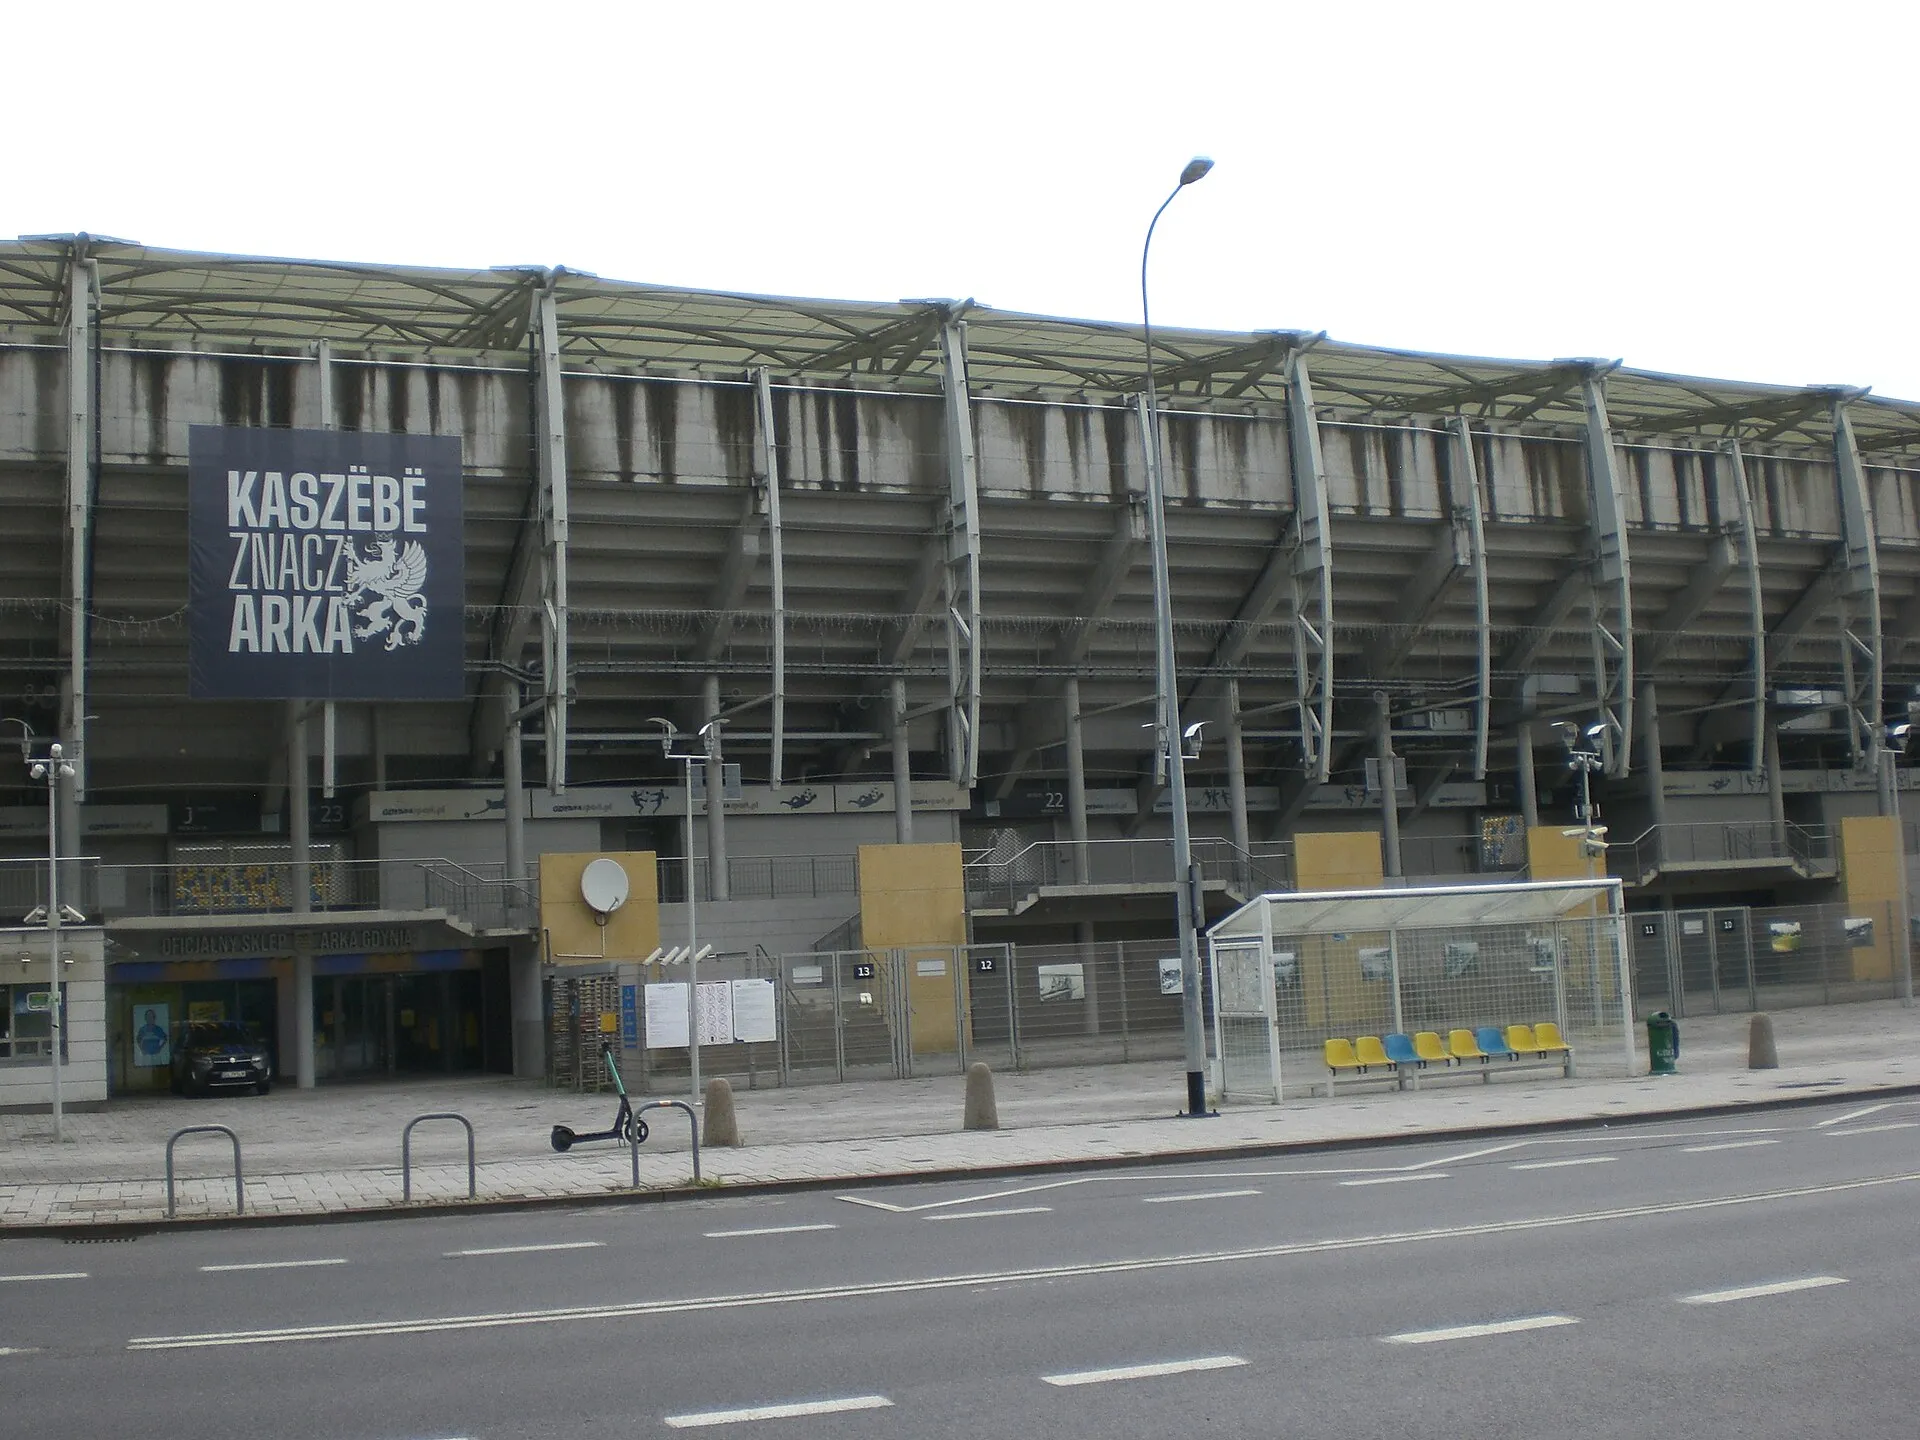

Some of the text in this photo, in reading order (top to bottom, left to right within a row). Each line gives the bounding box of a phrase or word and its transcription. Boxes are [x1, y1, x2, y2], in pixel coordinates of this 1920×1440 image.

[228, 465, 427, 532] KASZËBË
[228, 594, 353, 653] ARKA
[1045, 791, 1064, 808] 22
[320, 805, 344, 823] 23
[161, 928, 412, 956] OFICJALNY SKLEP ARKA GDYNIA
[857, 966, 870, 977] 13
[980, 960, 993, 970] 12
